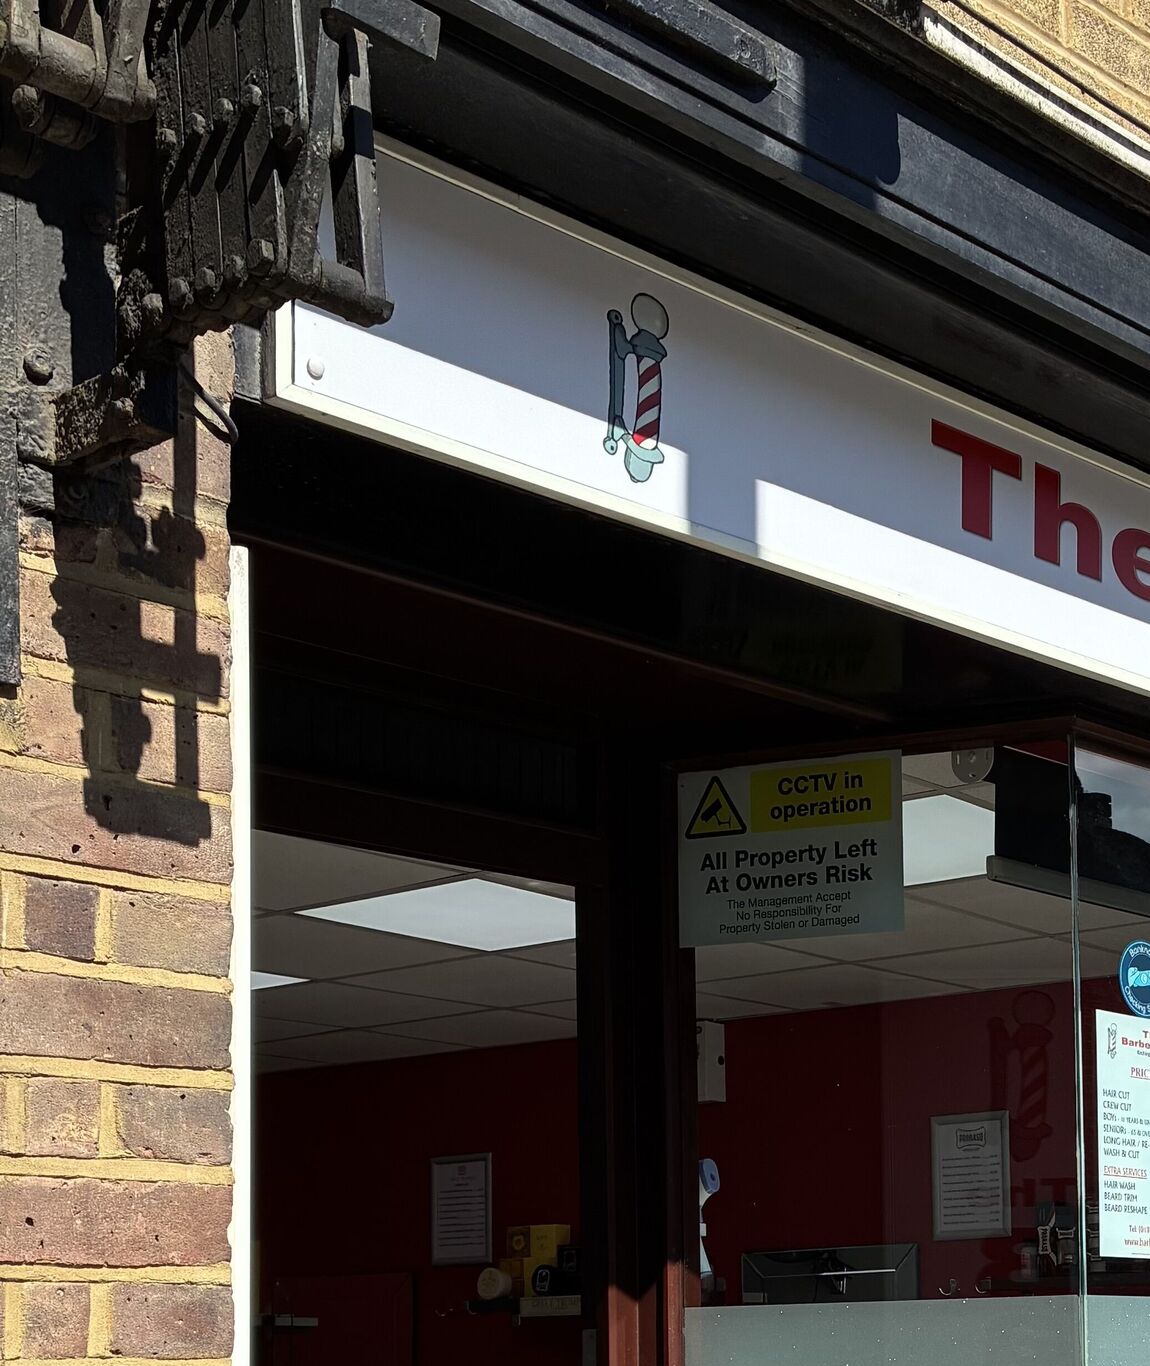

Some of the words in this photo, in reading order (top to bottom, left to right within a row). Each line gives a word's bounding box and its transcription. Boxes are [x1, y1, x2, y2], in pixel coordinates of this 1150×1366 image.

[778, 773, 837, 796] CCTV
[844, 772, 863, 789] in
[770, 796, 872, 822] operation
[700, 851, 727, 871] All
[735, 844, 826, 868] Property
[834, 839, 877, 859] Left
[705, 876, 729, 894] At
[736, 871, 818, 891] Owners
[826, 863, 873, 884] Risk
[728, 899, 745, 909] The
[748, 894, 812, 909] Management
[816, 891, 851, 903] Accept
[736, 911, 750, 921] No
[753, 905, 822, 920] Responsibility
[826, 903, 842, 913] For
[719, 923, 760, 935] Property
[763, 920, 795, 930] Stolen
[798, 921, 808, 929] or
[811, 914, 860, 928] Damaged
[1102, 1088, 1117, 1097] HAIR
[1118, 1090, 1130, 1100] CUT
[1103, 1100, 1118, 1110] CREW
[1120, 1102, 1131, 1111] CUT
[1103, 1136, 1121, 1146] LONG
[1122, 1138, 1136, 1147] HAIR
[1104, 1148, 1120, 1157] WASH
[1128, 1151, 1140, 1159] CUT
[1103, 1165, 1121, 1175] EXTRA
[1122, 1167, 1147, 1177] SERVICES
[1104, 1180, 1119, 1189] HAIR
[1119, 1182, 1136, 1191] WASH
[1104, 1191, 1122, 1201] BEARD
[1124, 1193, 1138, 1202] TRIM
[1104, 1203, 1122, 1213] BEARD
[1123, 1205, 1148, 1214] RESHAPE
